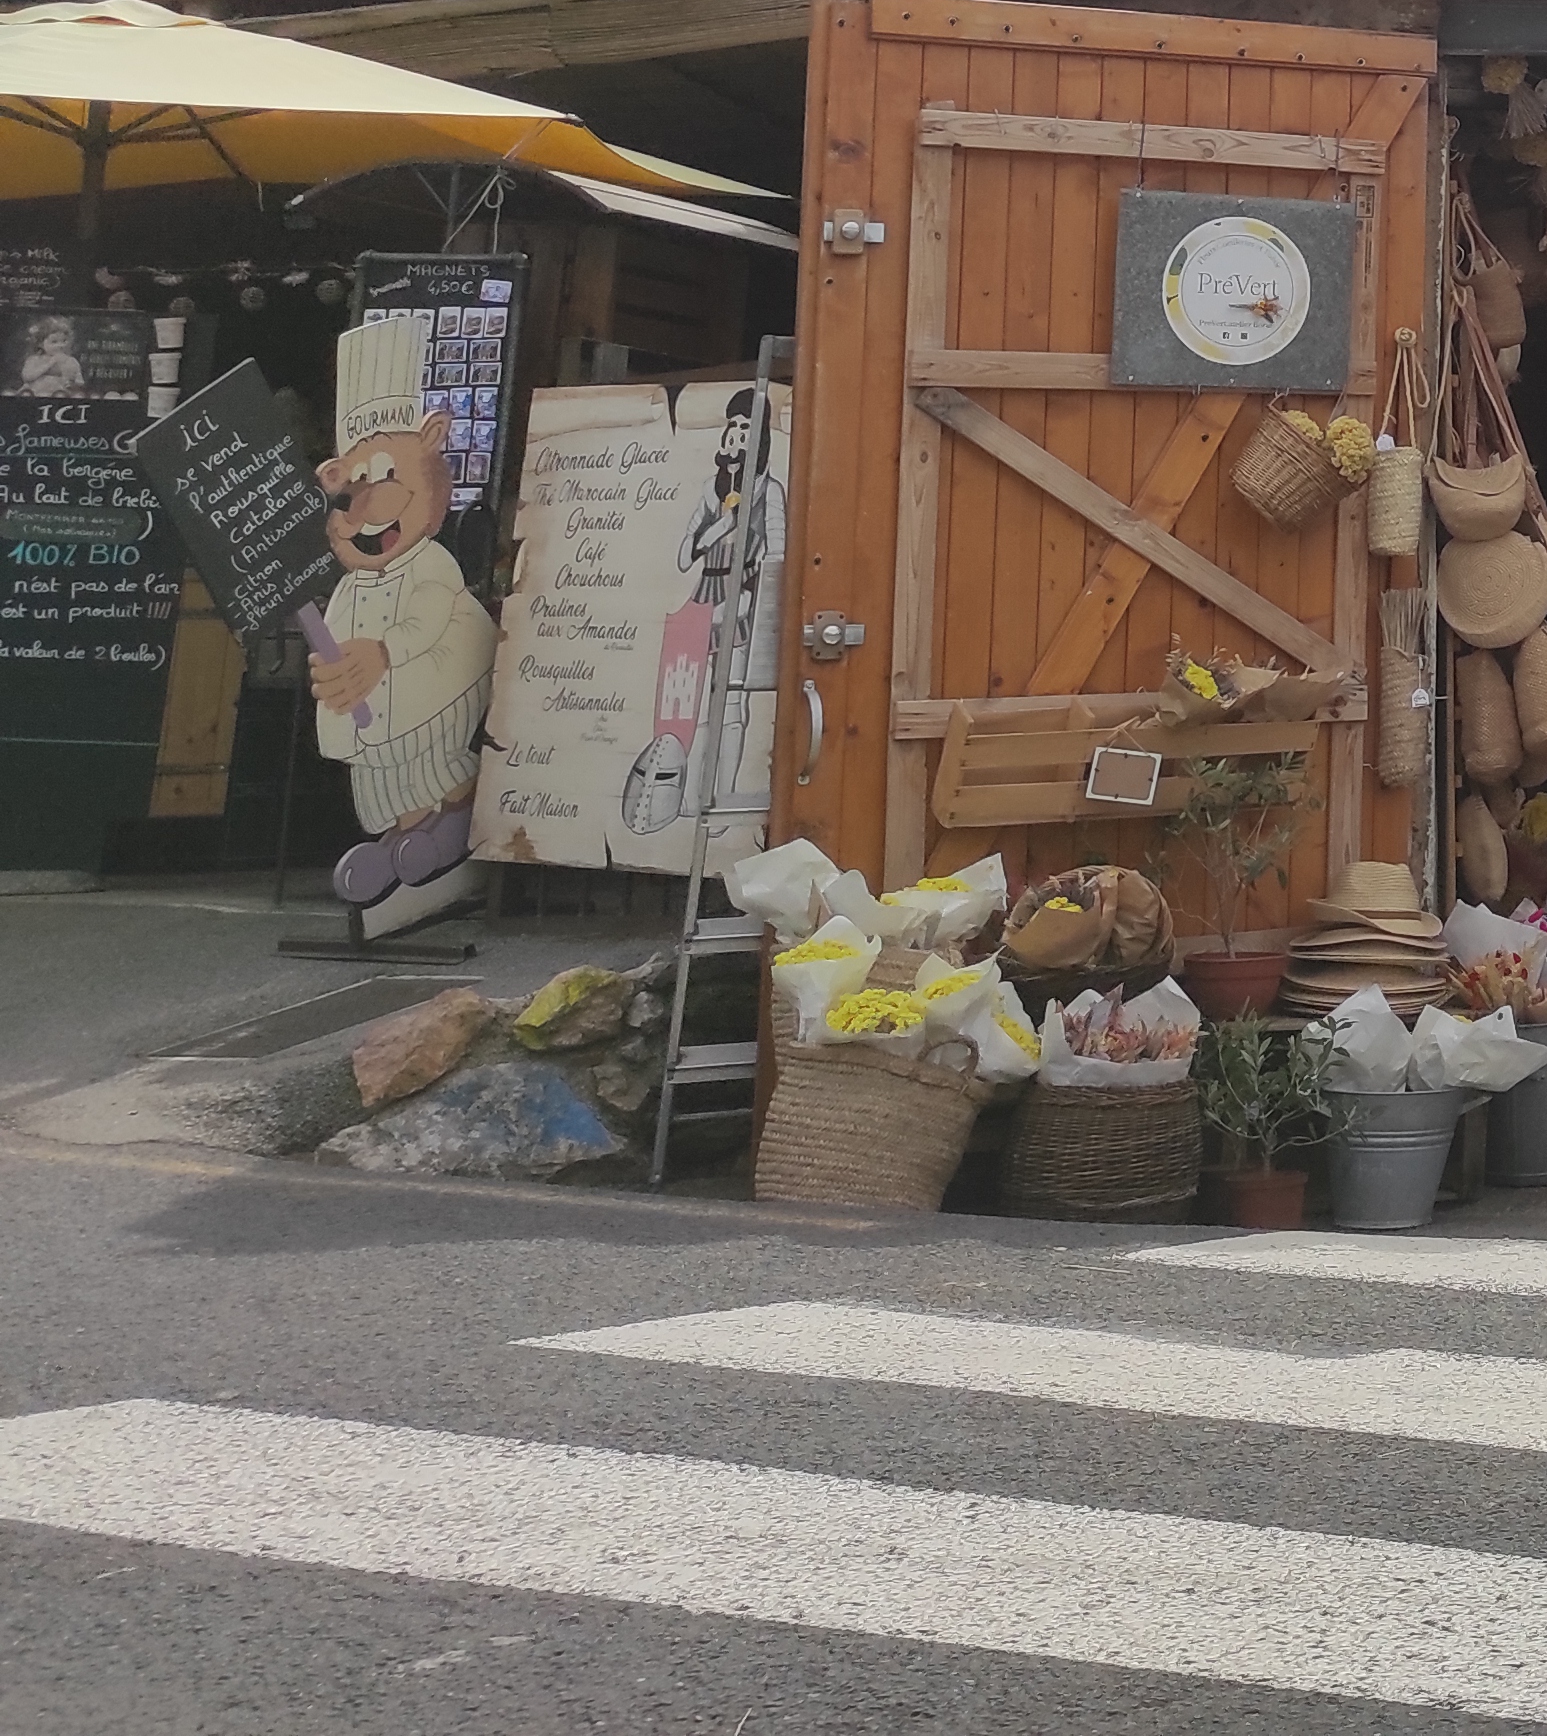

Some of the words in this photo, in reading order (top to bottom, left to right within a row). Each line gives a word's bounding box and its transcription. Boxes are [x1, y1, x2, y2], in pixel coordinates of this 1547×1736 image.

[407, 264, 490, 277] MAGNETS
[427, 280, 475, 295] 4,50€
[1197, 272, 1280, 298] PréVert
[37, 404, 91, 424] ICI
[346, 403, 416, 441] GOURMAND
[534, 445, 615, 477] Citronnade
[618, 441, 670, 476] Glacée
[175, 467, 199, 495] se
[188, 434, 295, 514] l'authentique
[78, 490, 104, 507] de
[209, 462, 296, 530] Rousquille
[558, 478, 628, 504] Marocain
[633, 477, 682, 511] Glacé
[564, 506, 626, 540] Granités
[7, 540, 78, 567] 100%
[88, 543, 140, 565] BIO
[575, 537, 609, 568] Café
[71, 580, 109, 600] pas
[114, 578, 139, 593] de
[554, 563, 626, 591] Chouchous
[33, 608, 59, 620] un
[68, 602, 143, 624] produit
[529, 594, 588, 620] Pralines
[536, 621, 565, 638] aux
[566, 615, 639, 641] Amandes
[64, 645, 86, 660] de
[518, 654, 596, 686] Rousquilles
[542, 686, 627, 713] Artisannales
[506, 740, 520, 768] Le
[525, 743, 557, 766] tout
[499, 789, 532, 816] Fait
[529, 792, 580, 820] Maison
